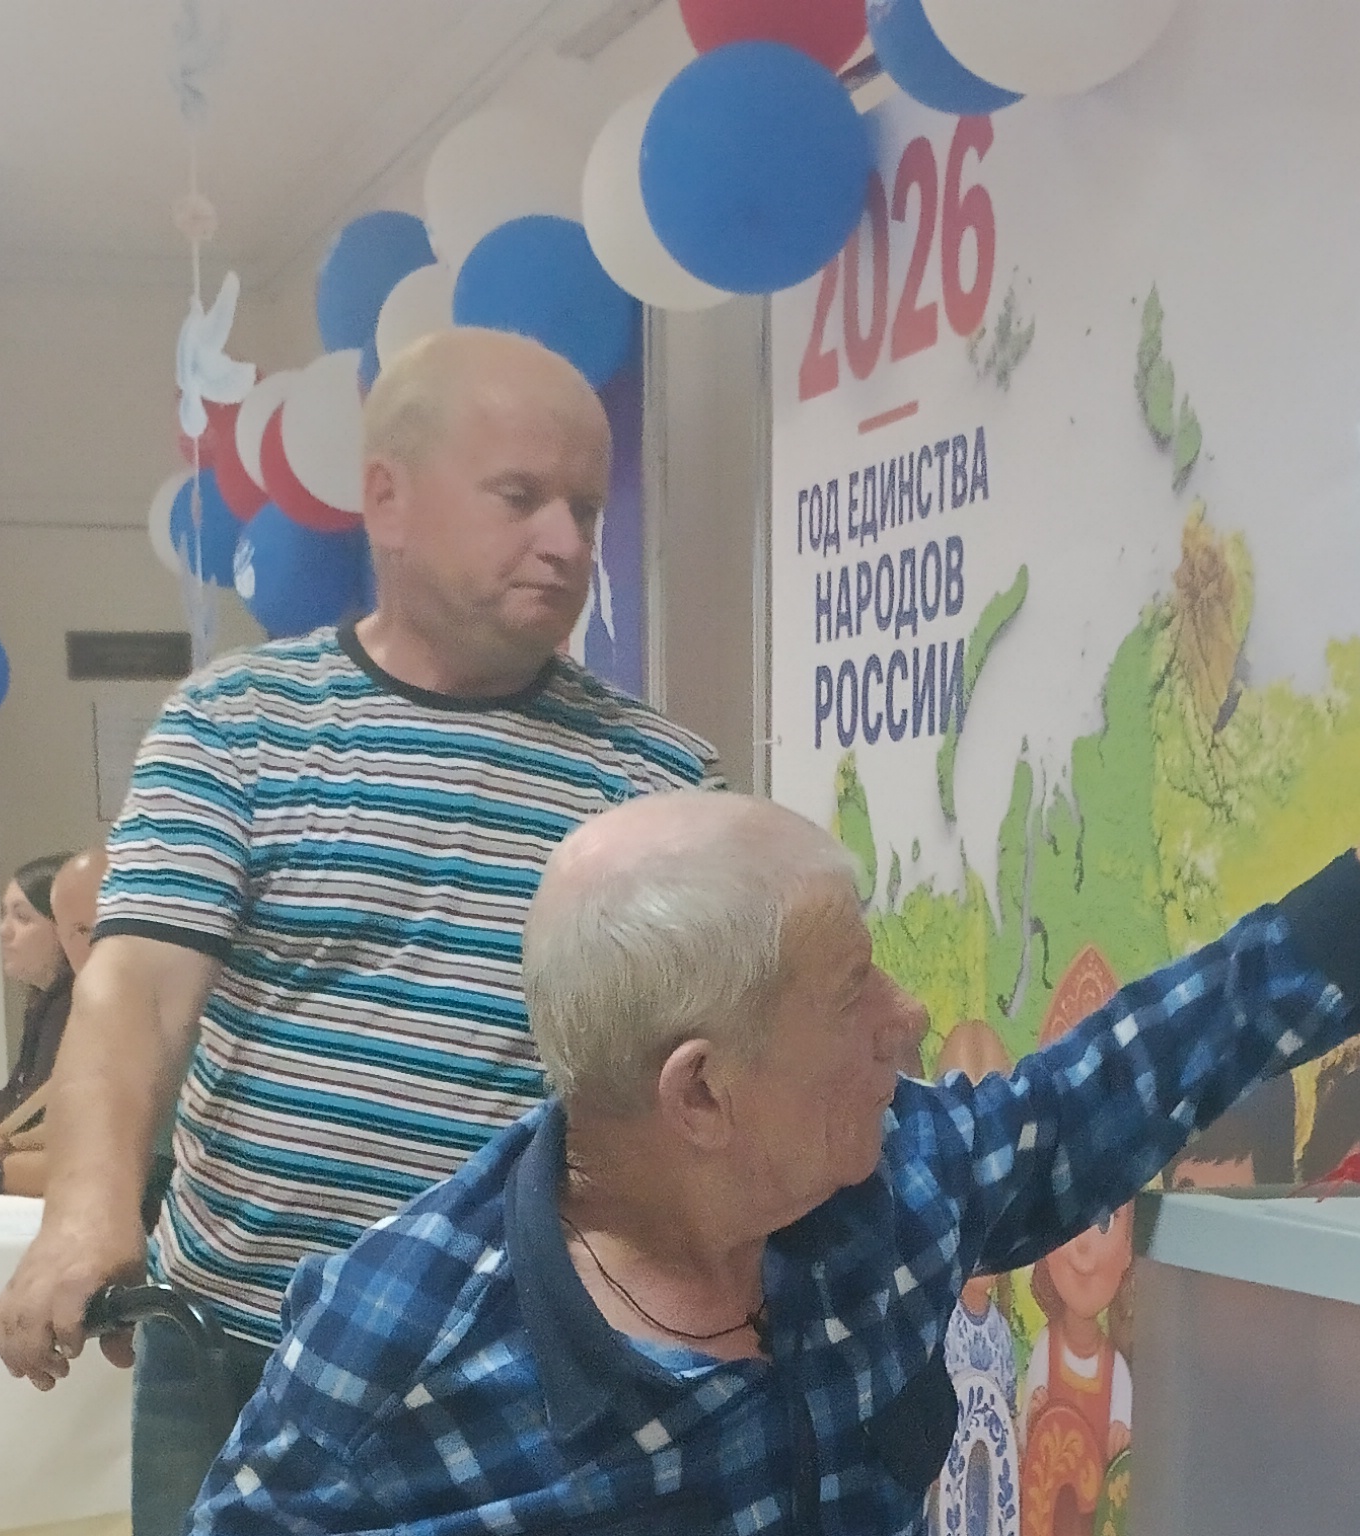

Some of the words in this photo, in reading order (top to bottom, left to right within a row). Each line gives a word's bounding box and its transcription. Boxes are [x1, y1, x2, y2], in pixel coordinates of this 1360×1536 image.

[798, 114, 996, 402] 2026
[797, 478, 840, 558] ГОД
[848, 425, 989, 547] ЕДИНСТВА
[815, 535, 965, 643] НАРОДОВ
[814, 637, 968, 750] РОССИИ
